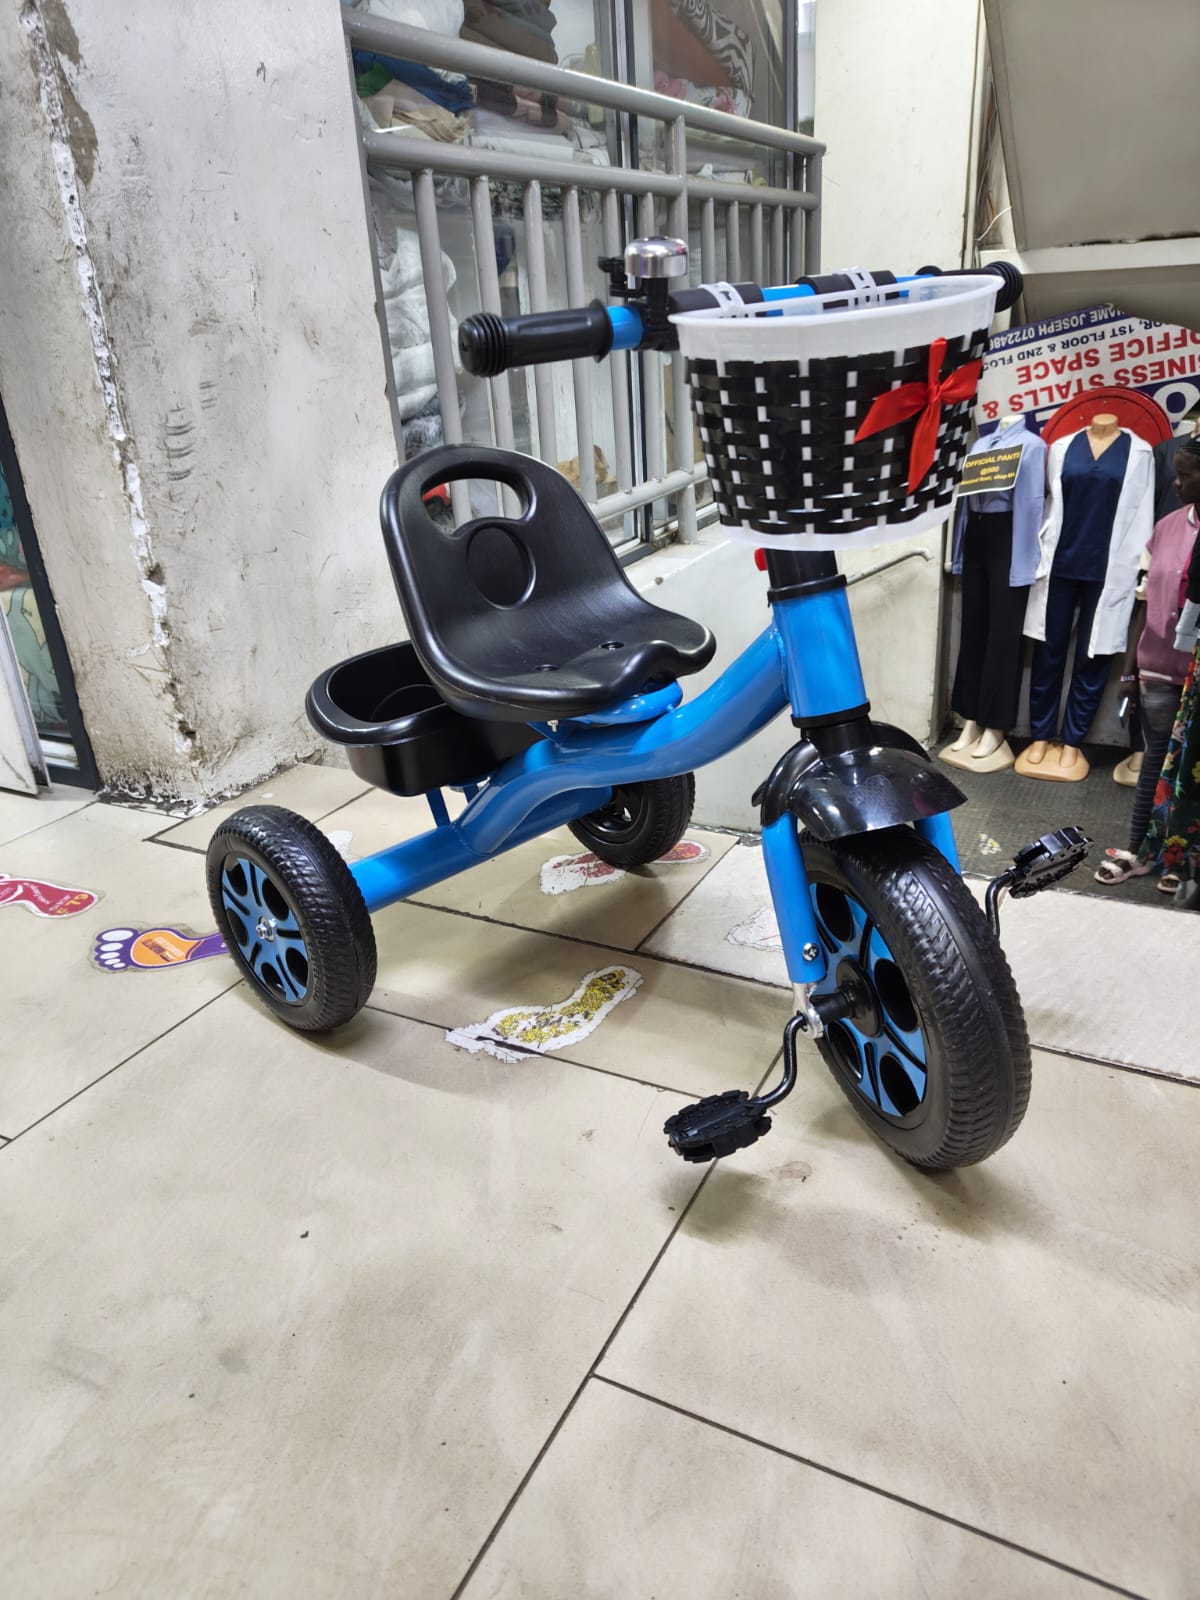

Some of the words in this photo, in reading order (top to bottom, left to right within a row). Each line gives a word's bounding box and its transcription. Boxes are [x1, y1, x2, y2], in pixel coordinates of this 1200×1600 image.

[1090, 306, 1125, 322] AME
[1038, 315, 1086, 337] JOSEPH
[1110, 323, 1135, 338] 1ST
[1049, 344, 1057, 353] &
[1061, 331, 1106, 349] FLOOR
[1017, 346, 1043, 361] 2ND
[1016, 348, 1100, 385] SPACE
[1114, 354, 1200, 388] INESS
[1008, 373, 1105, 412] STALLS
[982, 400, 999, 420] &
